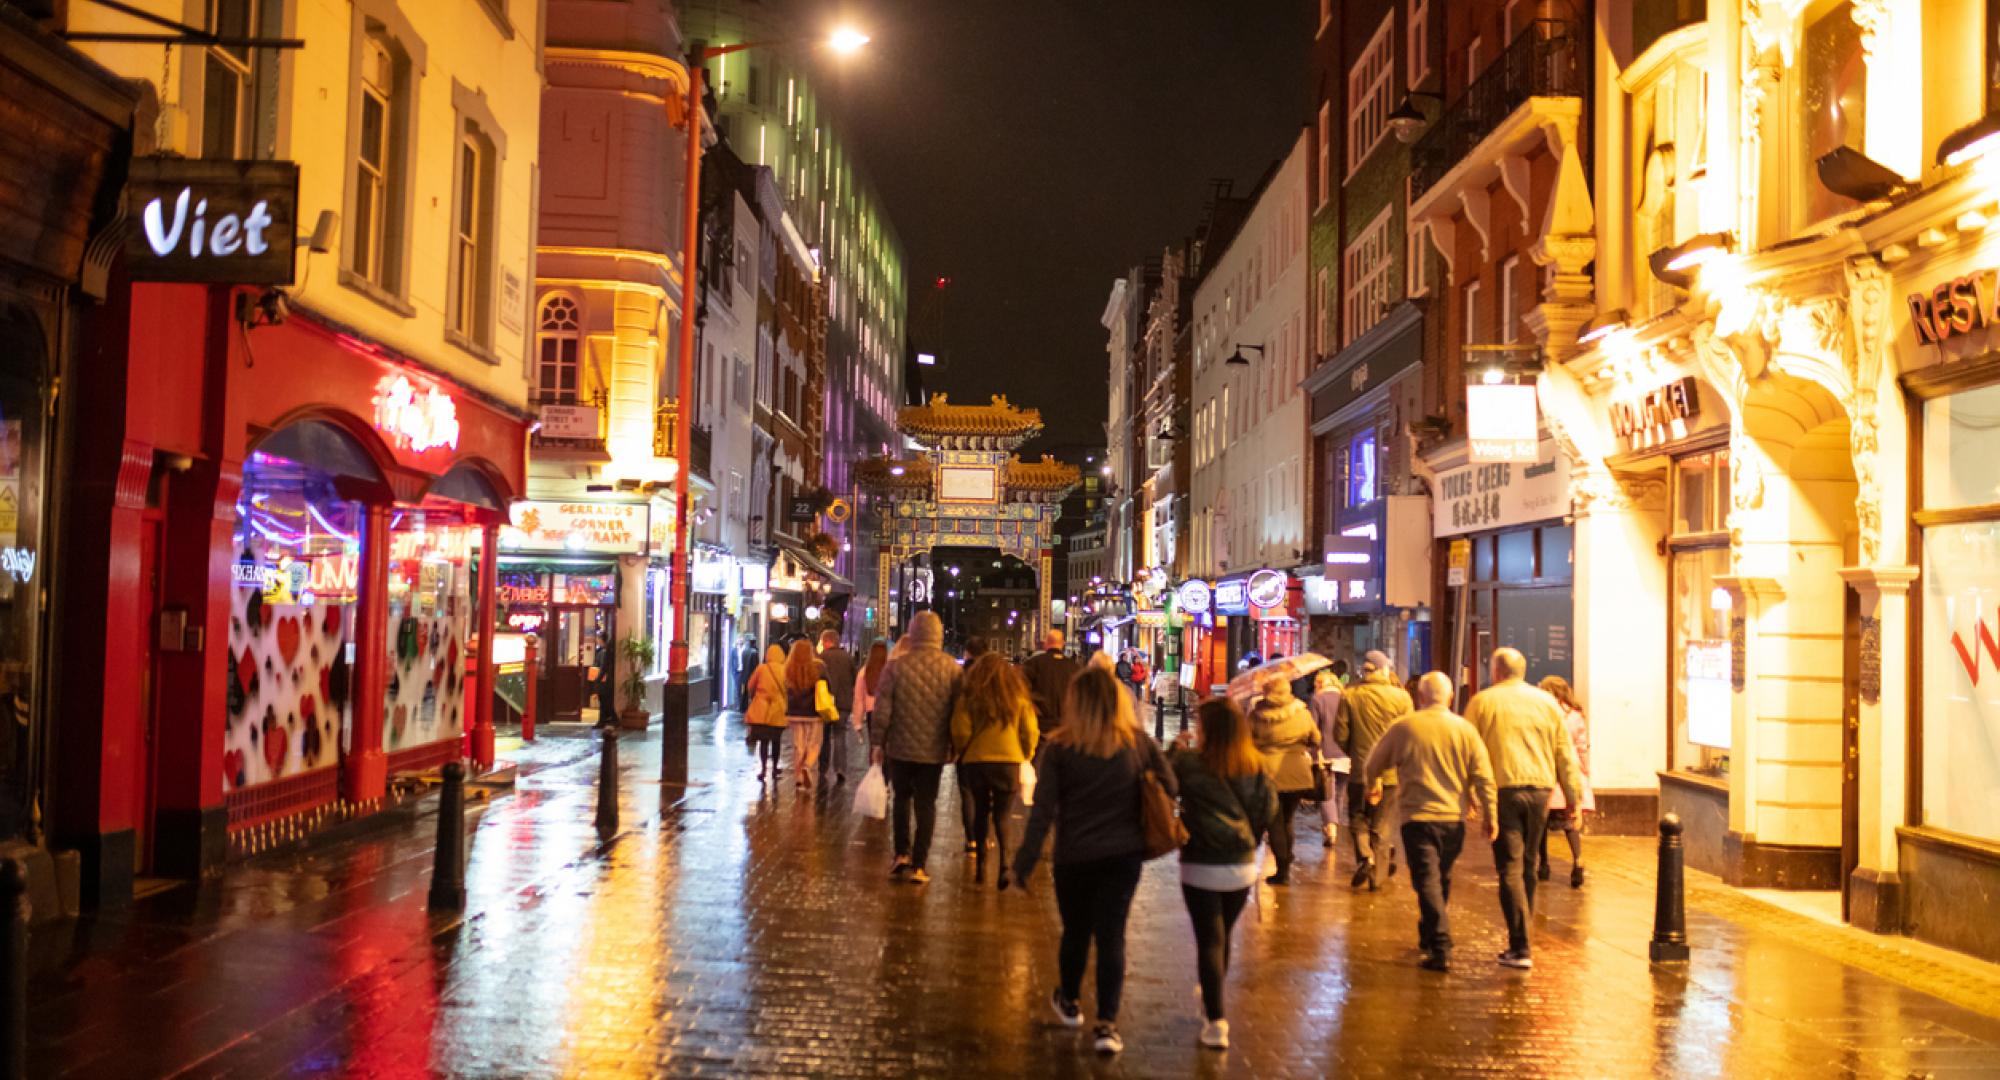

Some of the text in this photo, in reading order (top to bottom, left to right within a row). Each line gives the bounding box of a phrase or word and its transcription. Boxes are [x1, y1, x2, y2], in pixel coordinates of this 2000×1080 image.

[144, 186, 272, 259] Viet
[795, 502, 810, 513] 22
[571, 518, 625, 531] CORNER
